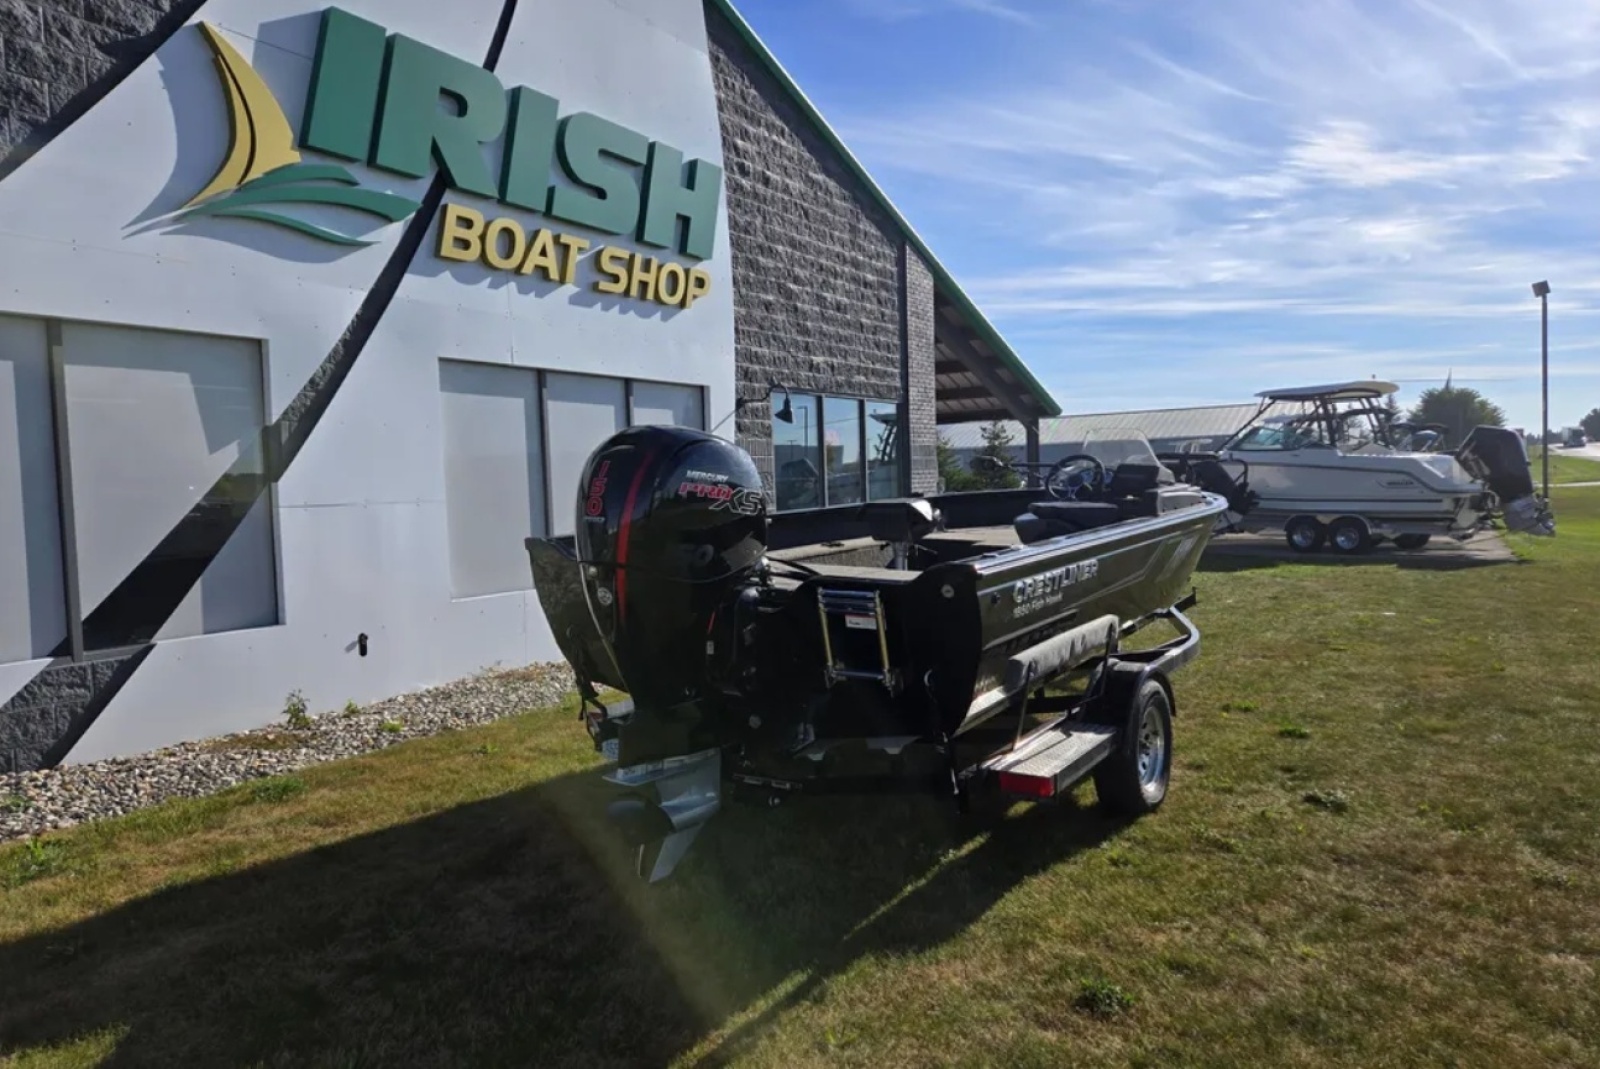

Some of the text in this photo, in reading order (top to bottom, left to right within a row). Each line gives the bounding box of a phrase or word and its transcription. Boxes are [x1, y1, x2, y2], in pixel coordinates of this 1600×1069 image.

[300, 6, 722, 260] IRISH
[435, 203, 712, 309] BOAT SHOP
[587, 460, 611, 516] 150
[678, 481, 762, 516] PRO XS
[685, 469, 729, 483] MERCURY
[1013, 559, 1098, 602] CRESTLINER
